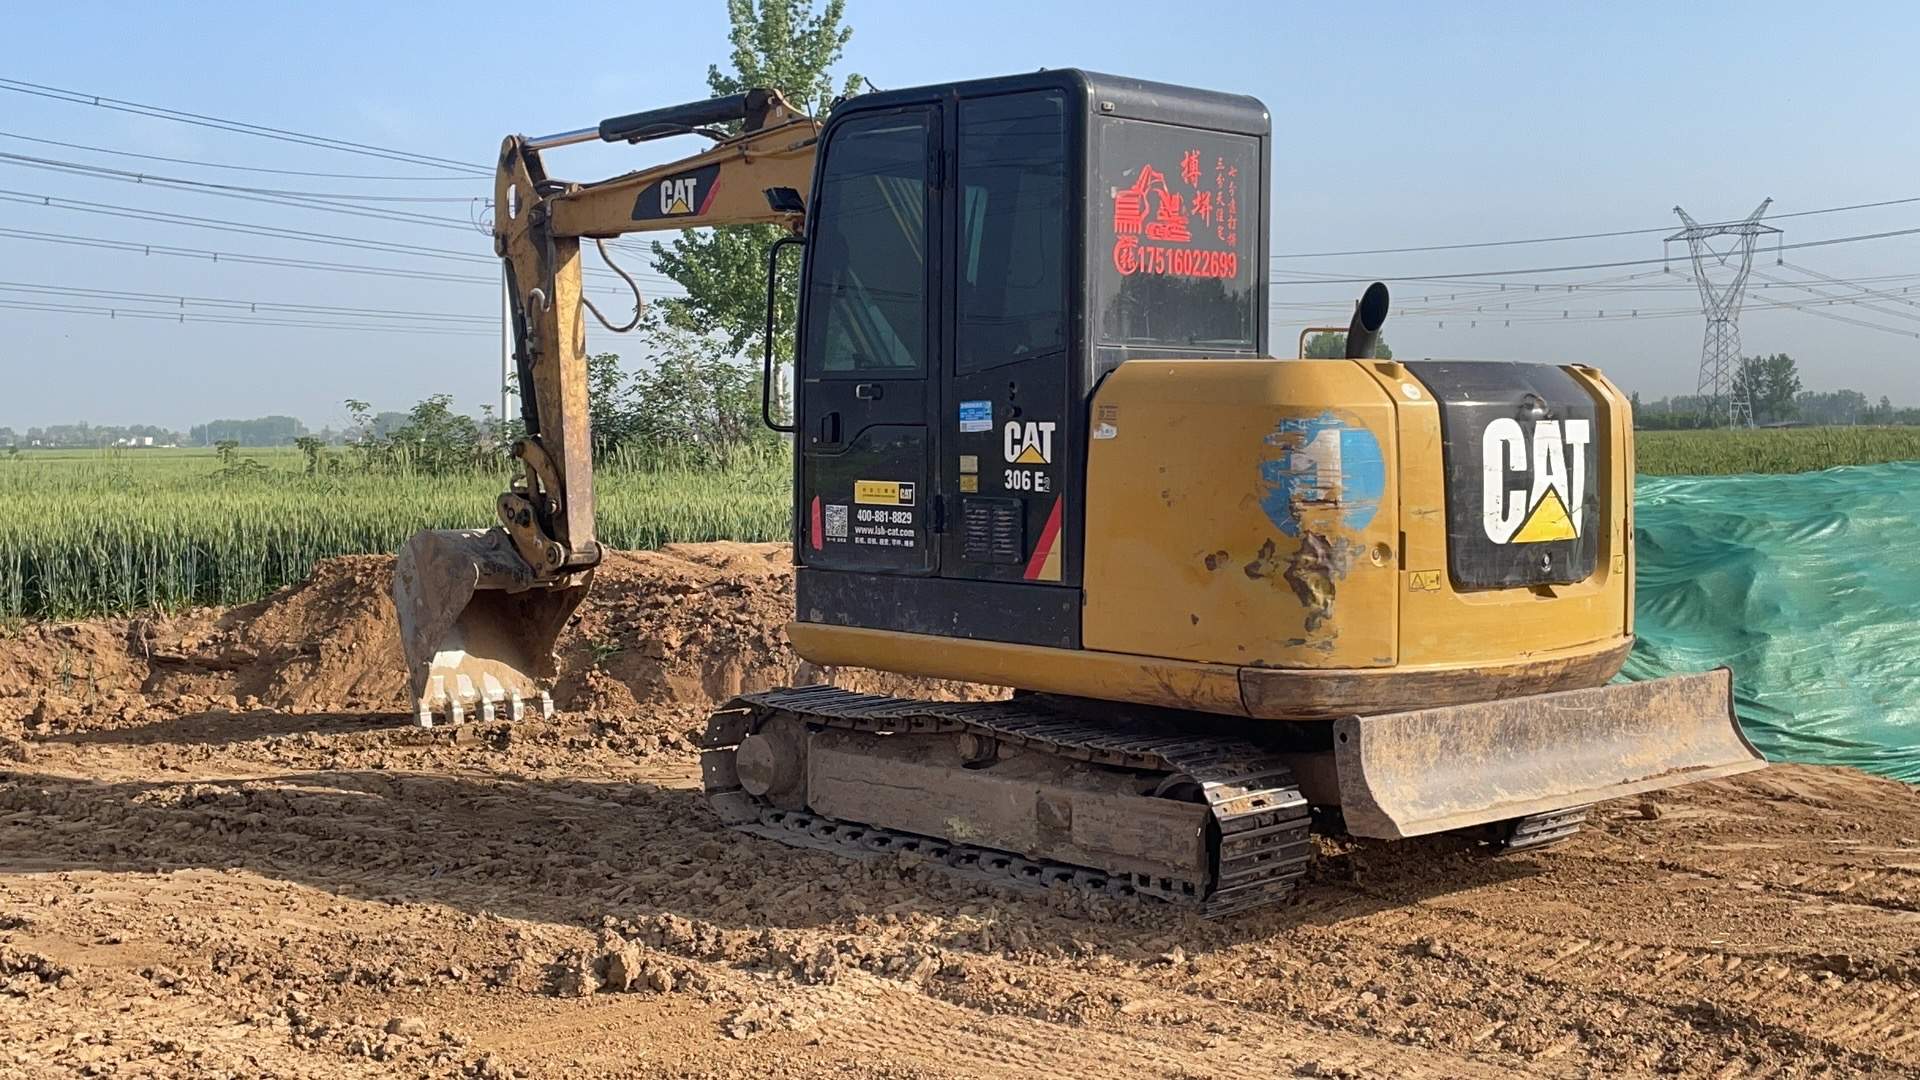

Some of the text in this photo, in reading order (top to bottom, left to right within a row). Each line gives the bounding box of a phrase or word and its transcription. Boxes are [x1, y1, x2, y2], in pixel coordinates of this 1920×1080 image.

[660, 177, 697, 215] CAT
[1138, 246, 1238, 279] 17516022699
[1004, 420, 1056, 464] CAT
[899, 488, 913, 500] CAT
[1004, 469, 1031, 491] 306
[1482, 417, 1590, 545] CAT
[856, 509, 913, 525] 400-881-8829
